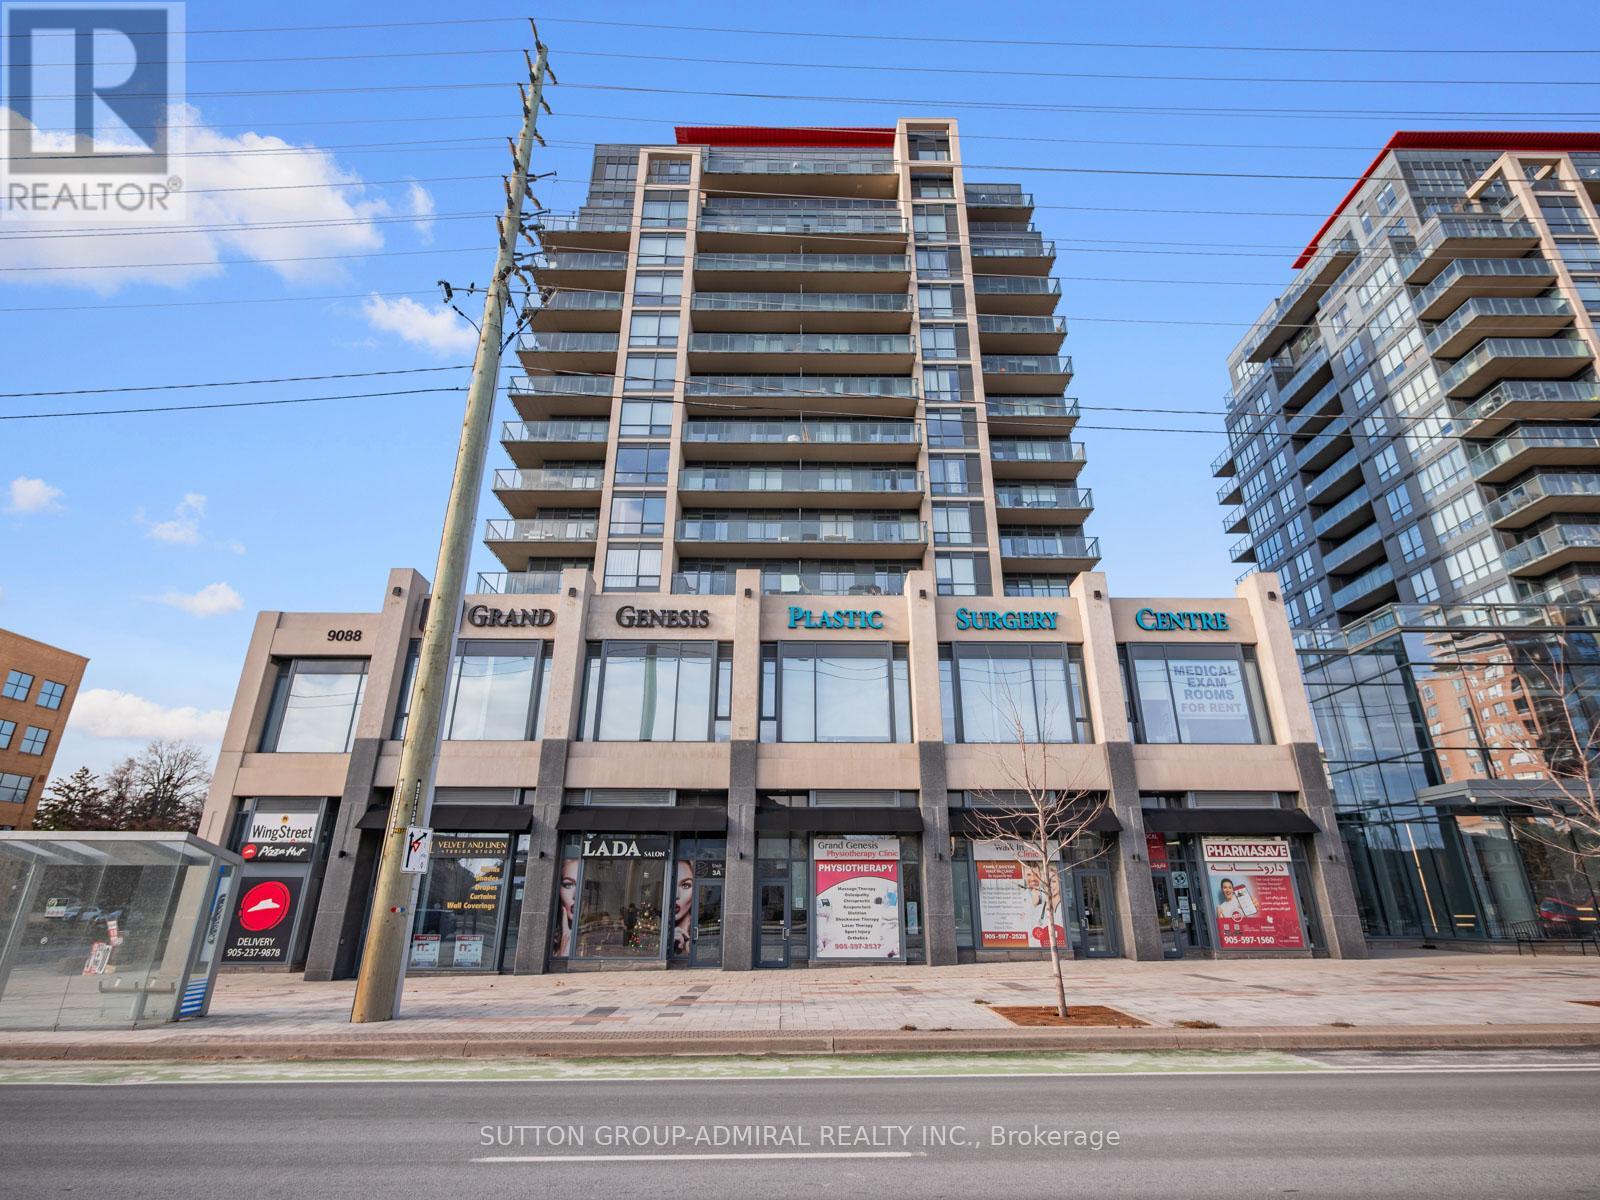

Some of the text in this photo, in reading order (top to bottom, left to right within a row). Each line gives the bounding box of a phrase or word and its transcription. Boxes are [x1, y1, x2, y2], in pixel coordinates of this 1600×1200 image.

[468, 605, 1230, 631] GRAND GENESIS PLASTIC SURGERY CENTRE
[327, 629, 362, 642] 9088
[1173, 665, 1237, 677] MEDICAL
[1187, 677, 1227, 687] EXAM
[1184, 689, 1235, 700] ROOMS
[1181, 703, 1242, 713] FOR RENT
[252, 825, 313, 841] WingStreet
[438, 841, 507, 849] VELVET AND LINEN
[582, 840, 642, 857] LADA
[818, 841, 879, 849] Grand Genesis
[258, 845, 307, 857] Pizza Hut
[826, 850, 877, 858] Physiotherapy
[1207, 844, 1288, 857] PHARMASAVE
[818, 864, 894, 872] PHYSIOTHERAPY
[463, 902, 496, 910] Coverings
[237, 937, 276, 946] DELIVERY
[1223, 936, 1275, 944] 905-597-1560
[227, 948, 281, 957] 905-237-9878
